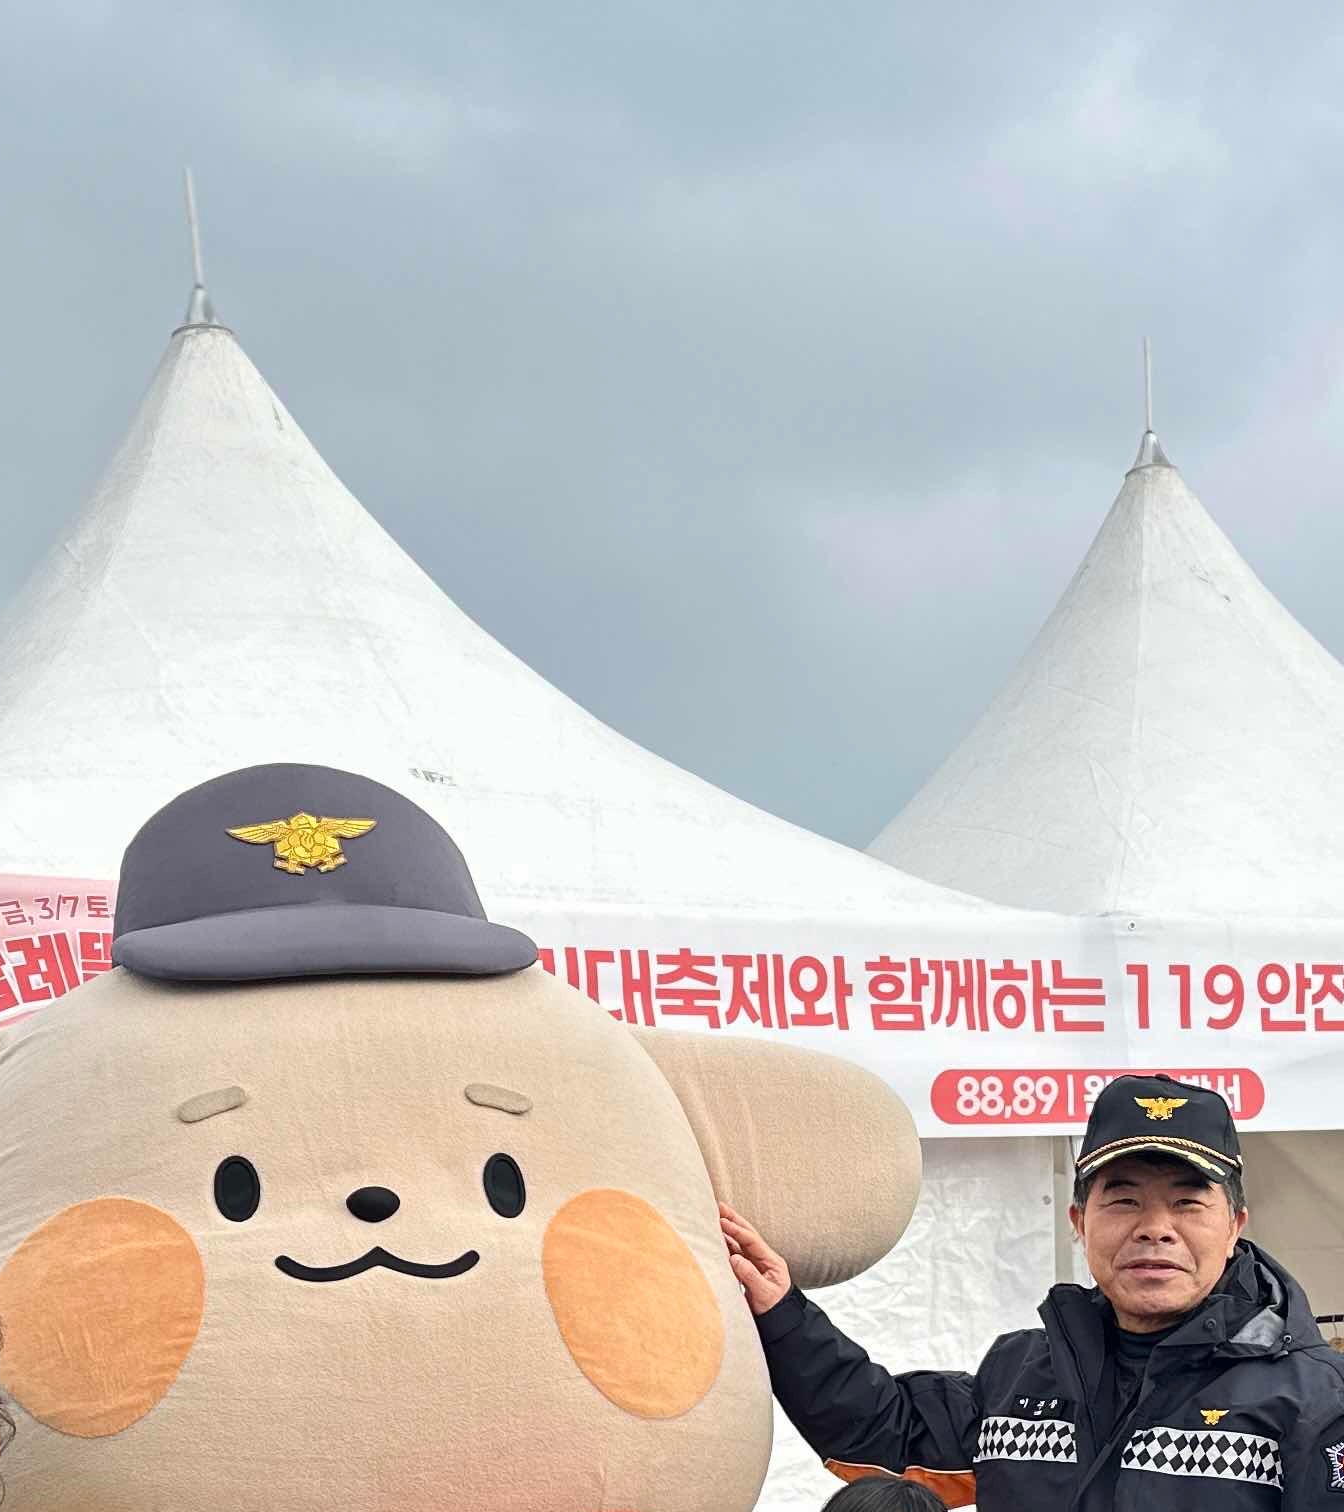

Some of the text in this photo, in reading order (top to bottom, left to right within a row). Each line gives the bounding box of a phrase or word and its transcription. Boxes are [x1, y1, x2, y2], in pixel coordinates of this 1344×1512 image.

[865, 955, 1106, 1032] 함께하는
[1126, 964, 1245, 1030] 119
[957, 1076, 1059, 1119] 88,89
